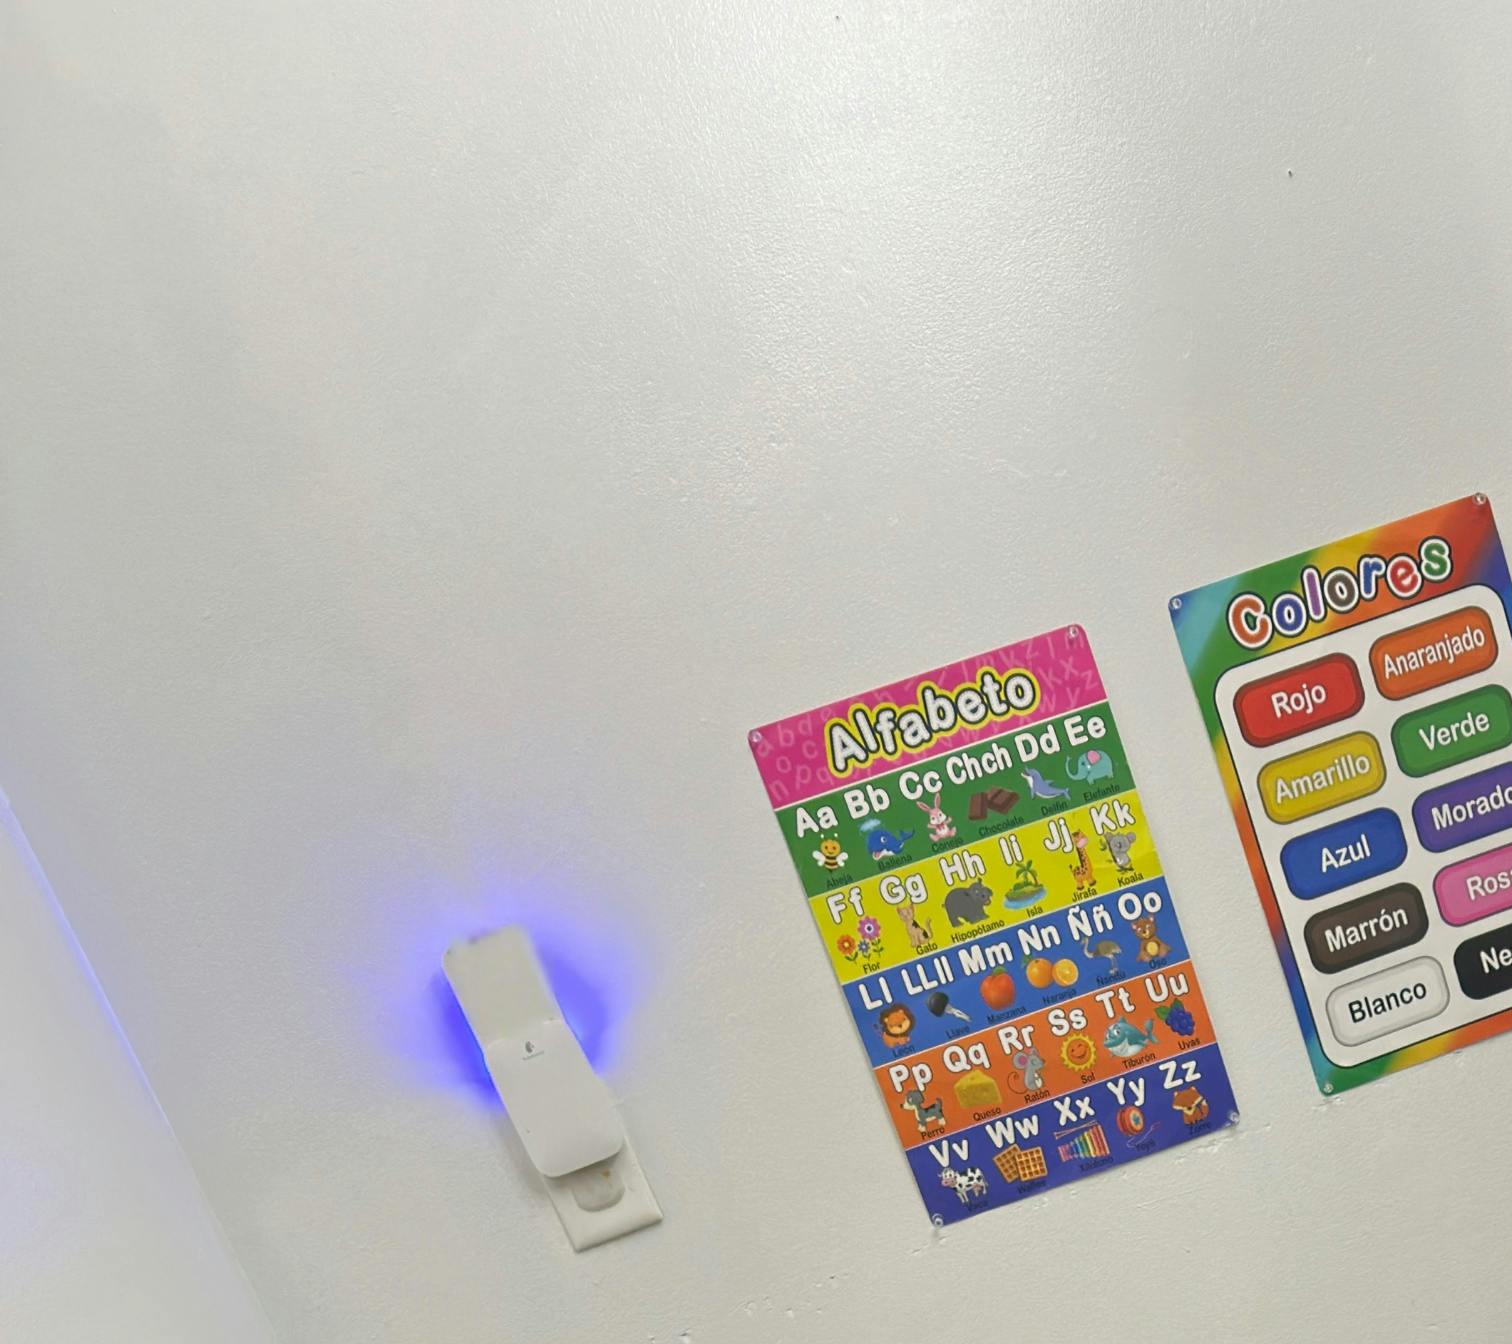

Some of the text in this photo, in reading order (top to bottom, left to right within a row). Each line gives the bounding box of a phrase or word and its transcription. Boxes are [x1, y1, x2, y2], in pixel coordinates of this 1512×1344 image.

[1226, 536, 1452, 649] Colores
[1383, 625, 1485, 679] Anaranjado
[1271, 682, 1327, 719] Rojo
[828, 671, 1036, 773] Alfabeto
[1419, 711, 1490, 751] Verde
[796, 715, 1107, 838] Aa Bb Cc Chch Dd Ee
[1083, 783, 1121, 802] Elefante
[1274, 752, 1371, 804] Amarillo
[978, 816, 1025, 838] Chocolate
[826, 799, 1136, 925] Ff Gg Hh Ii Jj Kk
[1320, 834, 1371, 873] Azul
[1072, 887, 1097, 902] Jirafa
[1117, 873, 1144, 887] Koala
[1026, 906, 1043, 918] Isla
[1324, 907, 1409, 953] Marrón
[858, 976, 893, 1010] Ll
[958, 941, 1013, 976] Mm
[1017, 924, 1060, 955] Nn
[1067, 904, 1113, 941] Ññ
[1117, 891, 1162, 920] Oo
[916, 942, 938, 956] Gato
[862, 962, 881, 975] Flor
[1347, 981, 1428, 1025] Blanco
[889, 973, 1189, 1092] Pp Qq Rr Ss Tt Uu
[1178, 1038, 1200, 1050] Uvas
[1081, 1072, 1095, 1084] Sol
[1122, 1053, 1156, 1069] Tiburón
[929, 1060, 1201, 1167] Vv Ww Xx Yy Zz
[973, 1107, 1001, 1121] Queso
[1024, 1089, 1050, 1104] Ratón
[920, 1127, 945, 1140] Perro
